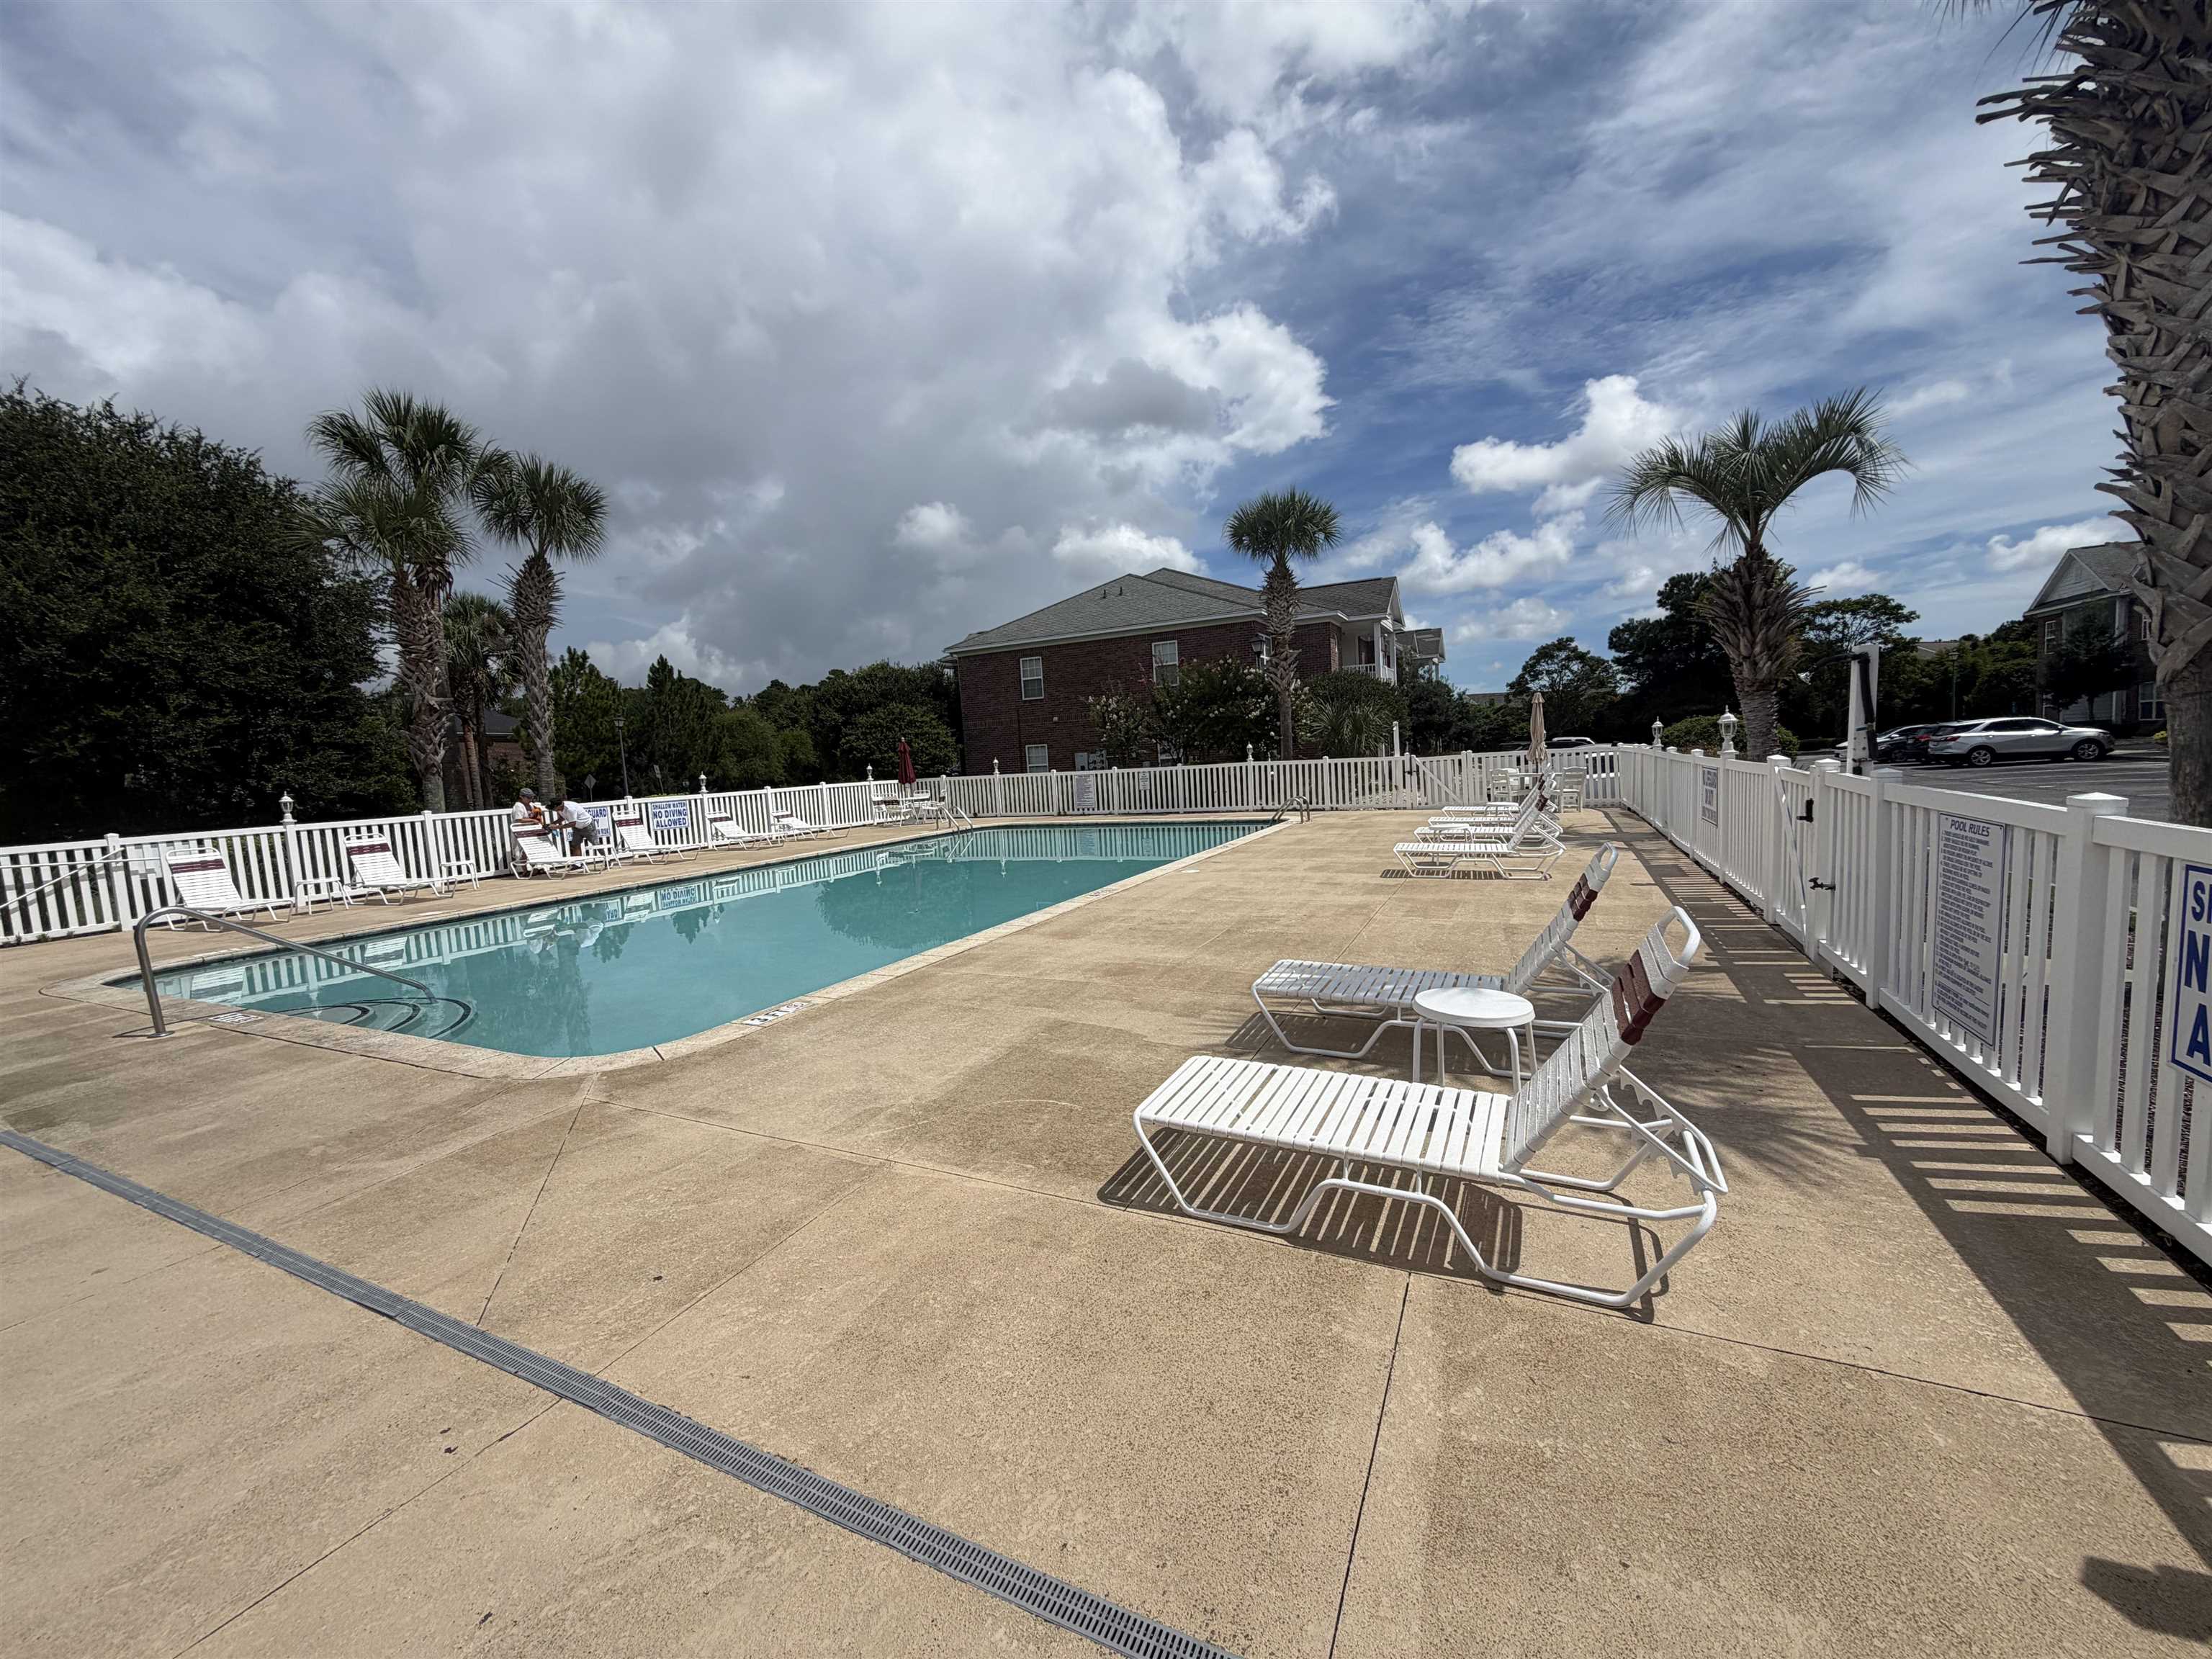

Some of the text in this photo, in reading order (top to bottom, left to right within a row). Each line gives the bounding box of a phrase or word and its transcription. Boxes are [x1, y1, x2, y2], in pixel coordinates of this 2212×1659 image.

[585, 808, 607, 818] GUARD
[653, 809, 687, 819] NO DIVING
[656, 817, 687, 827] ALLOWED
[1951, 819, 1990, 837] POOL RULES
